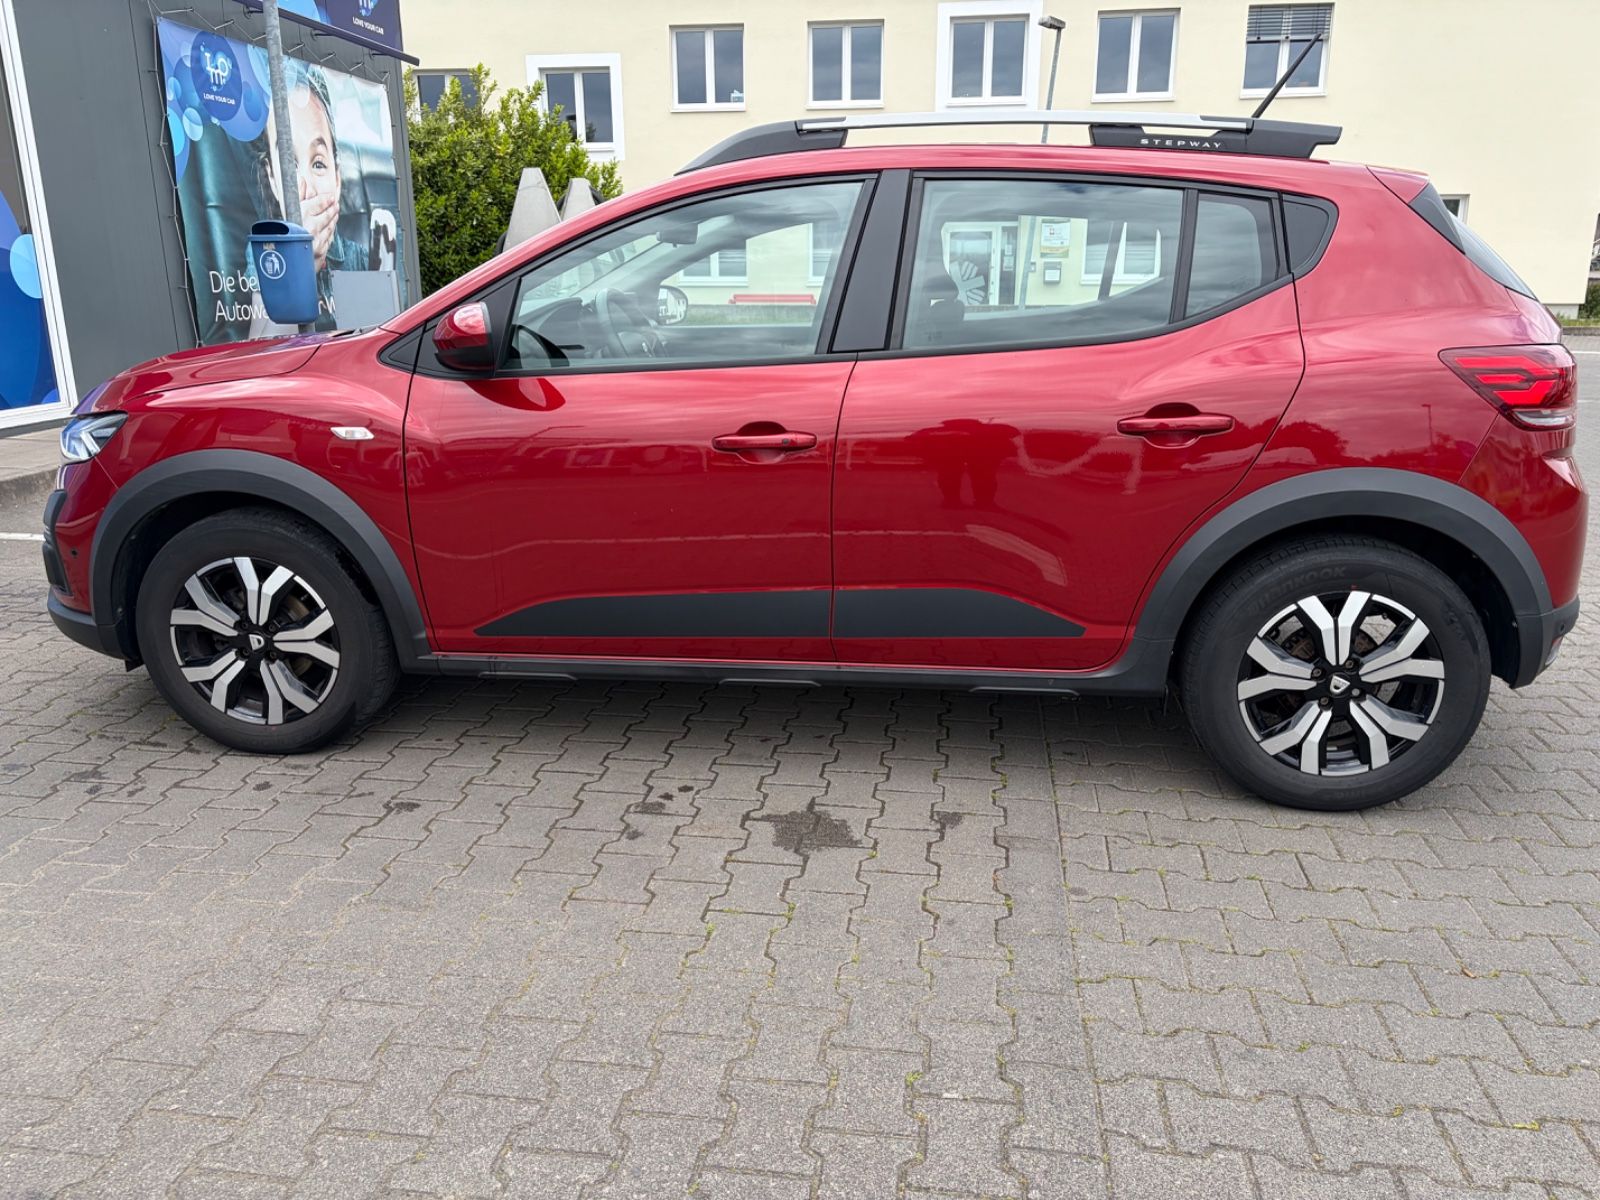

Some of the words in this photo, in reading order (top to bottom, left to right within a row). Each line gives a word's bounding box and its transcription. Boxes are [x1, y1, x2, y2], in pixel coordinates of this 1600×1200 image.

[203, 92, 214, 101] LOVE
[215, 95, 226, 103] YOUR
[1140, 139, 1221, 149] STEPWAY
[209, 270, 236, 293] Die
[237, 270, 260, 292] be
